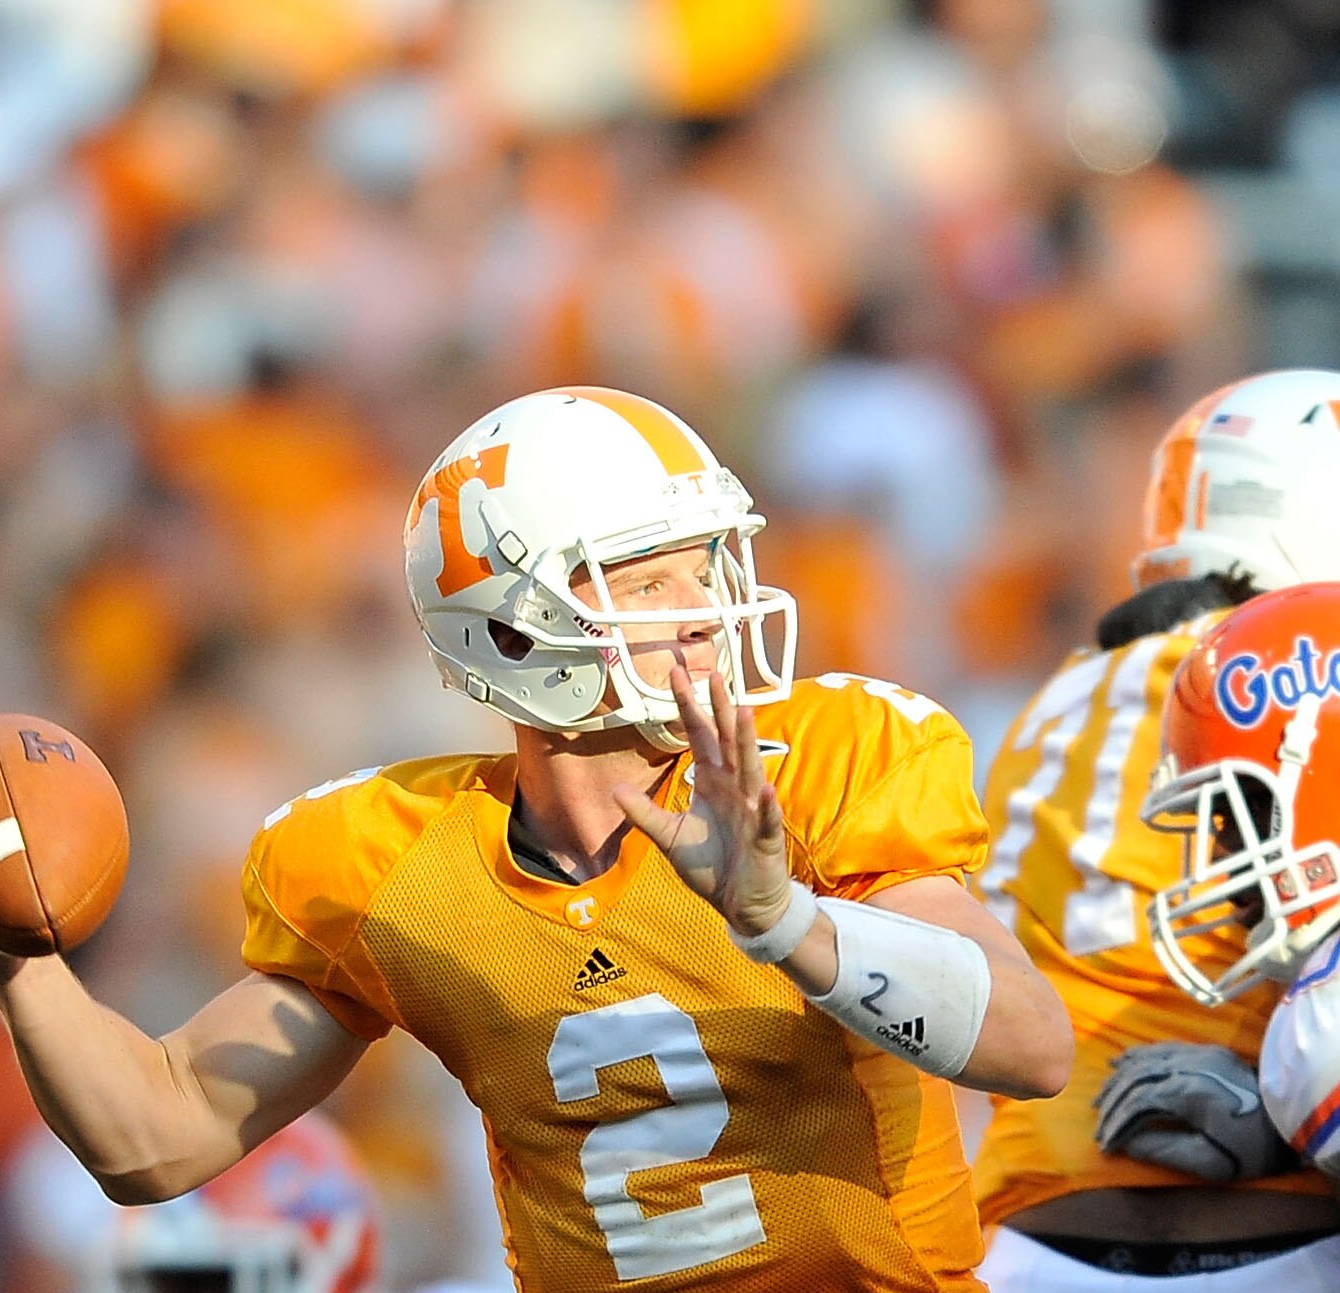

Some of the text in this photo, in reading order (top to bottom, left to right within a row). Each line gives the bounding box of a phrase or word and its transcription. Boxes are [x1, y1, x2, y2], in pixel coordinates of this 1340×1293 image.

[568, 896, 596, 926] T
[574, 966, 628, 992] adidas
[860, 972, 889, 1016] 2
[876, 1024, 924, 1058] adidas
[547, 993, 767, 1280] 2
